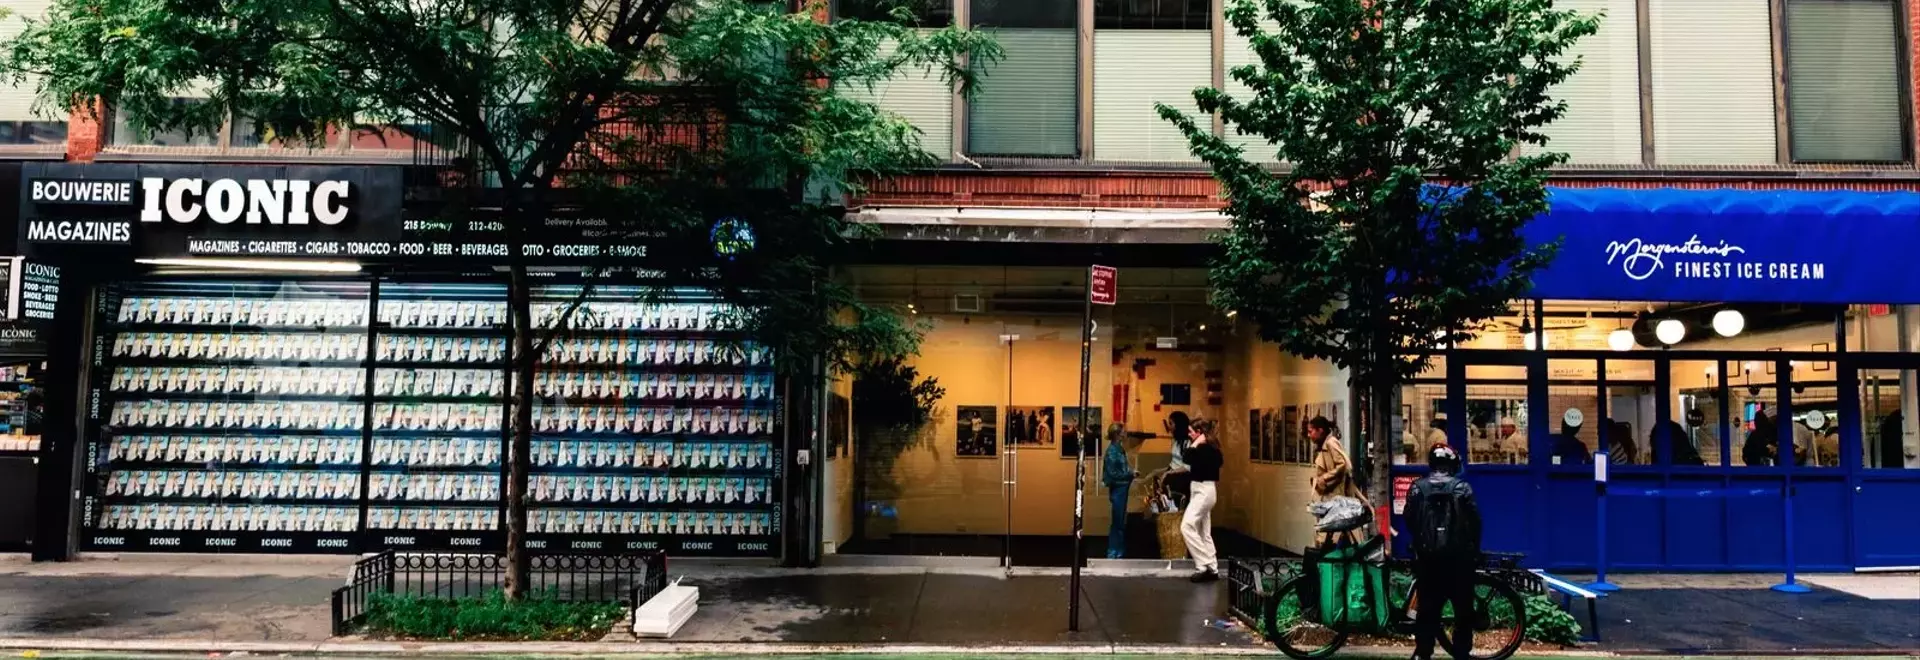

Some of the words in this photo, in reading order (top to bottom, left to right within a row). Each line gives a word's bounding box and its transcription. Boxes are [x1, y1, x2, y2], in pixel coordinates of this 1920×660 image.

[32, 181, 130, 201] BOUWERIE
[141, 177, 349, 225] ICONIC
[404, 220, 418, 230] 215
[545, 218, 573, 227] Delivery
[28, 220, 130, 242] MAGAZINES
[189, 240, 240, 253] MAGAZINES
[248, 241, 297, 254] CIGARETTES
[305, 241, 338, 254] CIGARS
[347, 242, 390, 255] TOBACCO
[399, 243, 424, 255] FOOD
[433, 243, 453, 255] BEER
[461, 243, 509, 256] BEVERAGES
[521, 244, 544, 256] OTTO
[552, 244, 600, 257] GROCERIES
[1605, 234, 1745, 280] Morgenstern's
[24, 262, 60, 278] ICONIC
[1675, 262, 1731, 278] FINEST
[1738, 263, 1763, 279] ICE
[1769, 263, 1825, 279] CREAM
[23, 282, 39, 292] FOOD
[41, 284, 60, 294] LOTTO
[25, 300, 55, 311] BEVERAGES
[1, 328, 37, 338] ICONIC
[95, 335, 104, 366] ICONIC
[91, 388, 100, 419] ICONIC
[87, 442, 96, 473] ICONIC
[84, 495, 93, 528] ICONIC
[93, 536, 125, 545] ICONIC
[150, 537, 181, 546] ICONIC
[205, 538, 237, 546] ICONIC
[261, 538, 292, 547] ICONIC
[317, 539, 349, 547] ICONIC
[384, 536, 415, 545] ICONIC
[450, 537, 481, 546] ICONIC
[525, 540, 547, 549] ONIC
[571, 540, 602, 549] ICONIC
[627, 541, 658, 549] ICONIC
[682, 541, 713, 550] ICONIC
[737, 542, 768, 551] ICONIC
